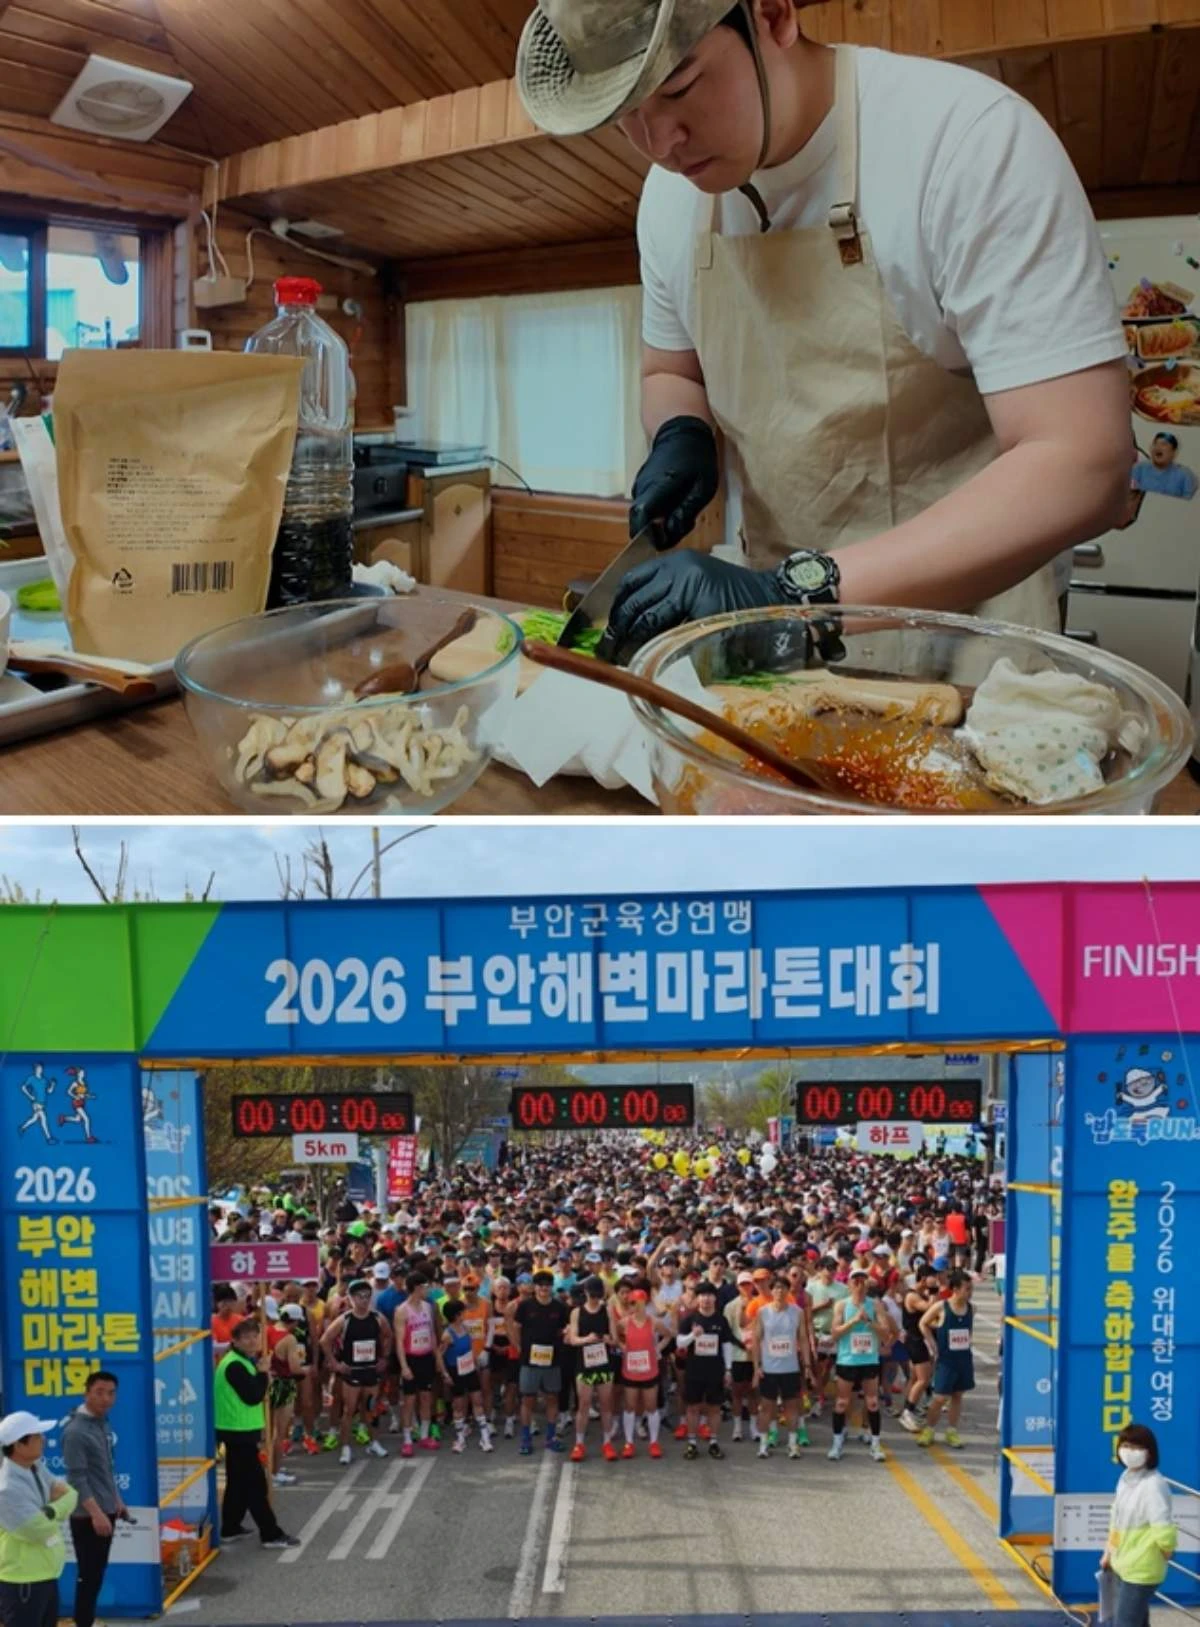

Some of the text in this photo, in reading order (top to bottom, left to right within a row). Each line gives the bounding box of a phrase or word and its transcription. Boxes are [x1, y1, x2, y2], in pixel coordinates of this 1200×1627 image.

[509, 900, 752, 939] 부안군육상연맹
[1083, 943, 1200, 977] FINISH
[264, 942, 940, 1026] 2026 부안해변마라톤대회
[303, 1139, 348, 1157] 5km
[868, 1125, 911, 1145] 하프
[14, 1165, 97, 1204] 2026
[17, 1214, 97, 1259] 부안
[20, 1268, 99, 1308] 해변
[1150, 1180, 1177, 1422] 2026 위대한 여정
[22, 1312, 141, 1353] 마라톤
[24, 1356, 101, 1397] 대회
